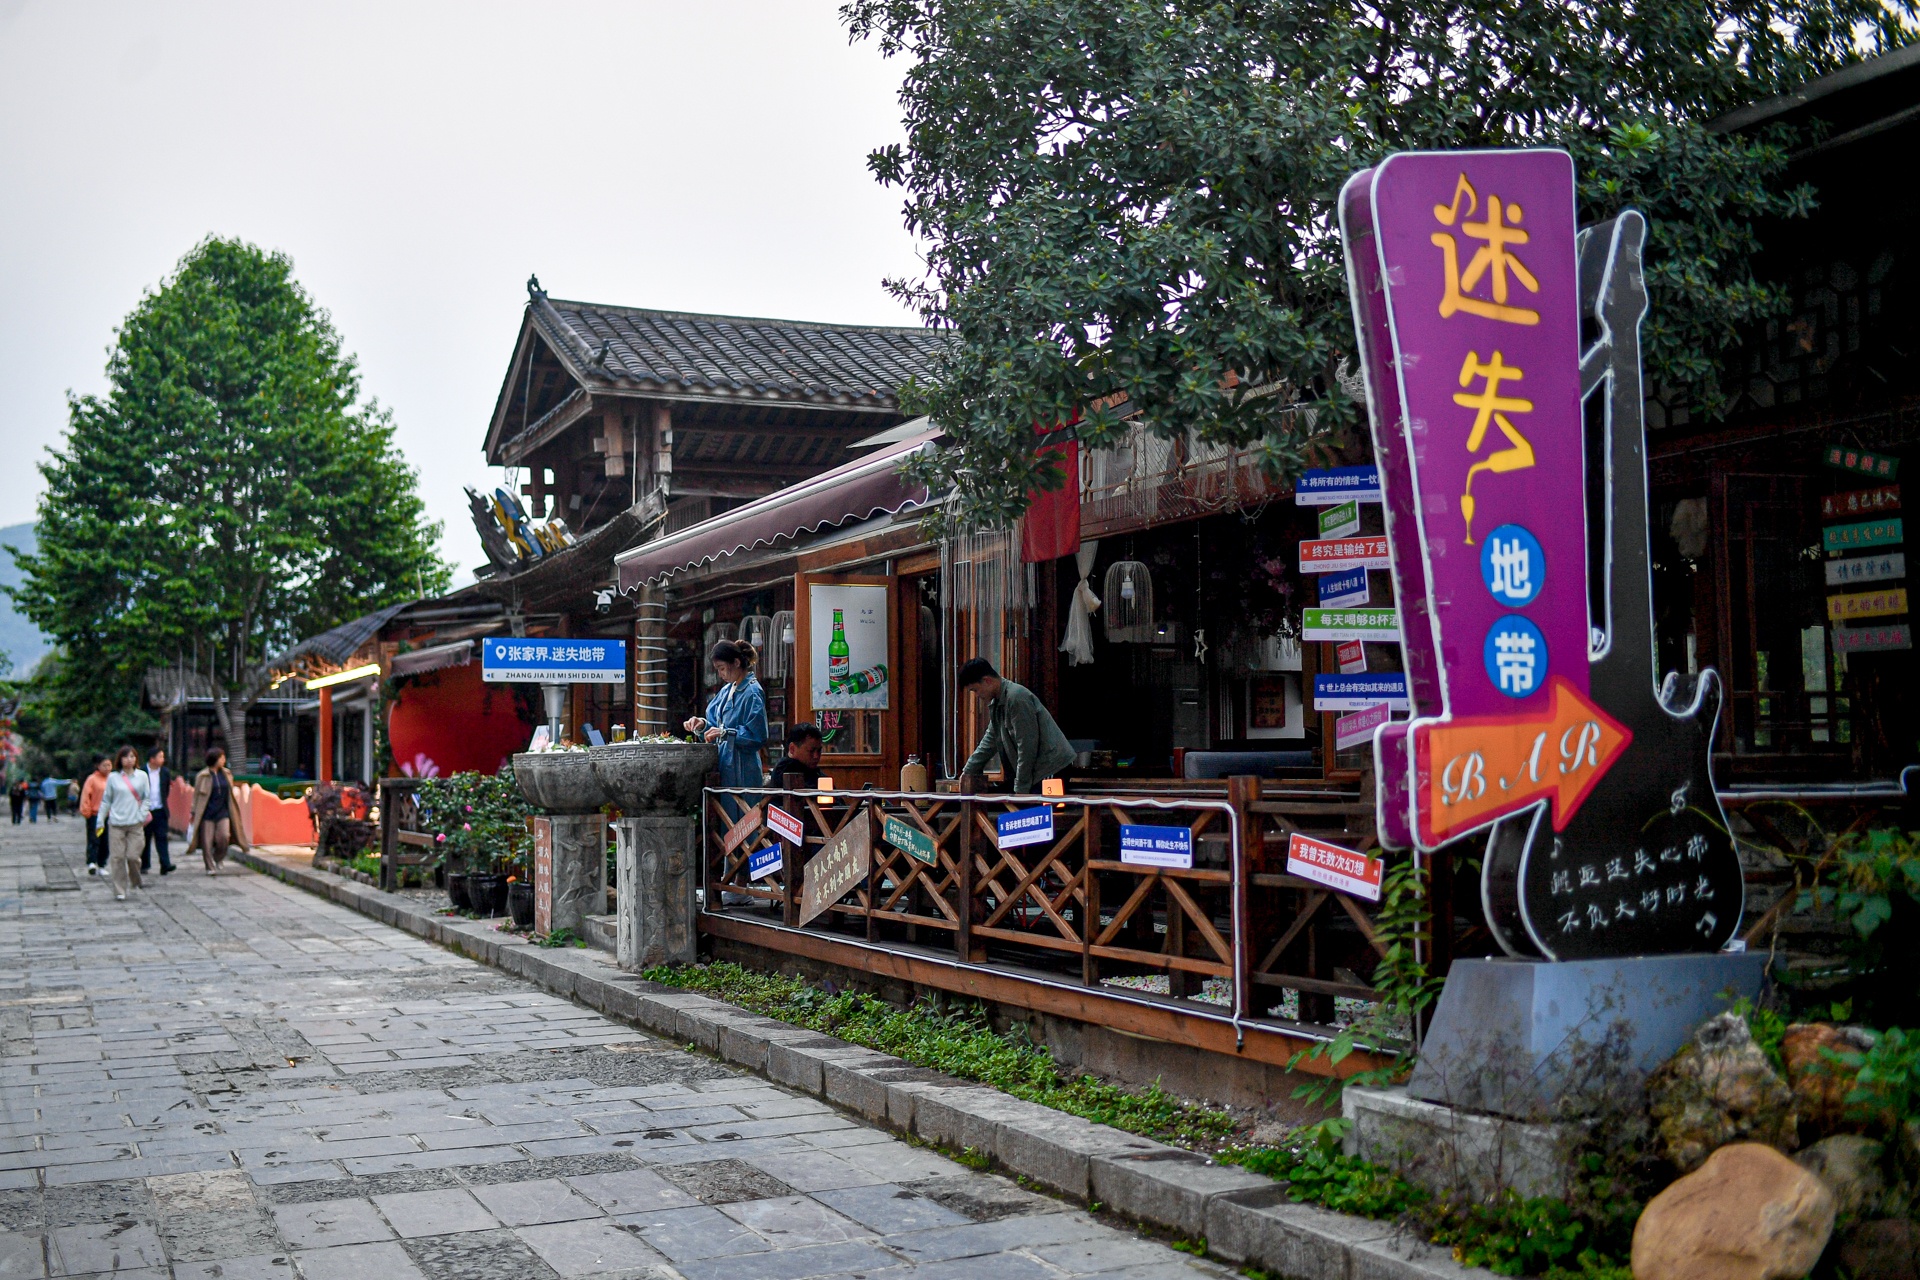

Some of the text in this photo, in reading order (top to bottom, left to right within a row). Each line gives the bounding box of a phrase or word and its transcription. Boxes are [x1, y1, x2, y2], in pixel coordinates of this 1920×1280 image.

[1431, 172, 1540, 694] 迷失地带
[1309, 475, 1380, 487] 将所有的情绪一饮
[1312, 541, 1387, 557] 终究是输给了爱
[1320, 613, 1399, 626] 每天喝够8杯酒
[1442, 721, 1600, 806] BAR
[1046, 786, 1053, 795] 3
[1299, 843, 1365, 876] 我曾无数次幻想
[1557, 875, 1715, 933] 不负大好时光
